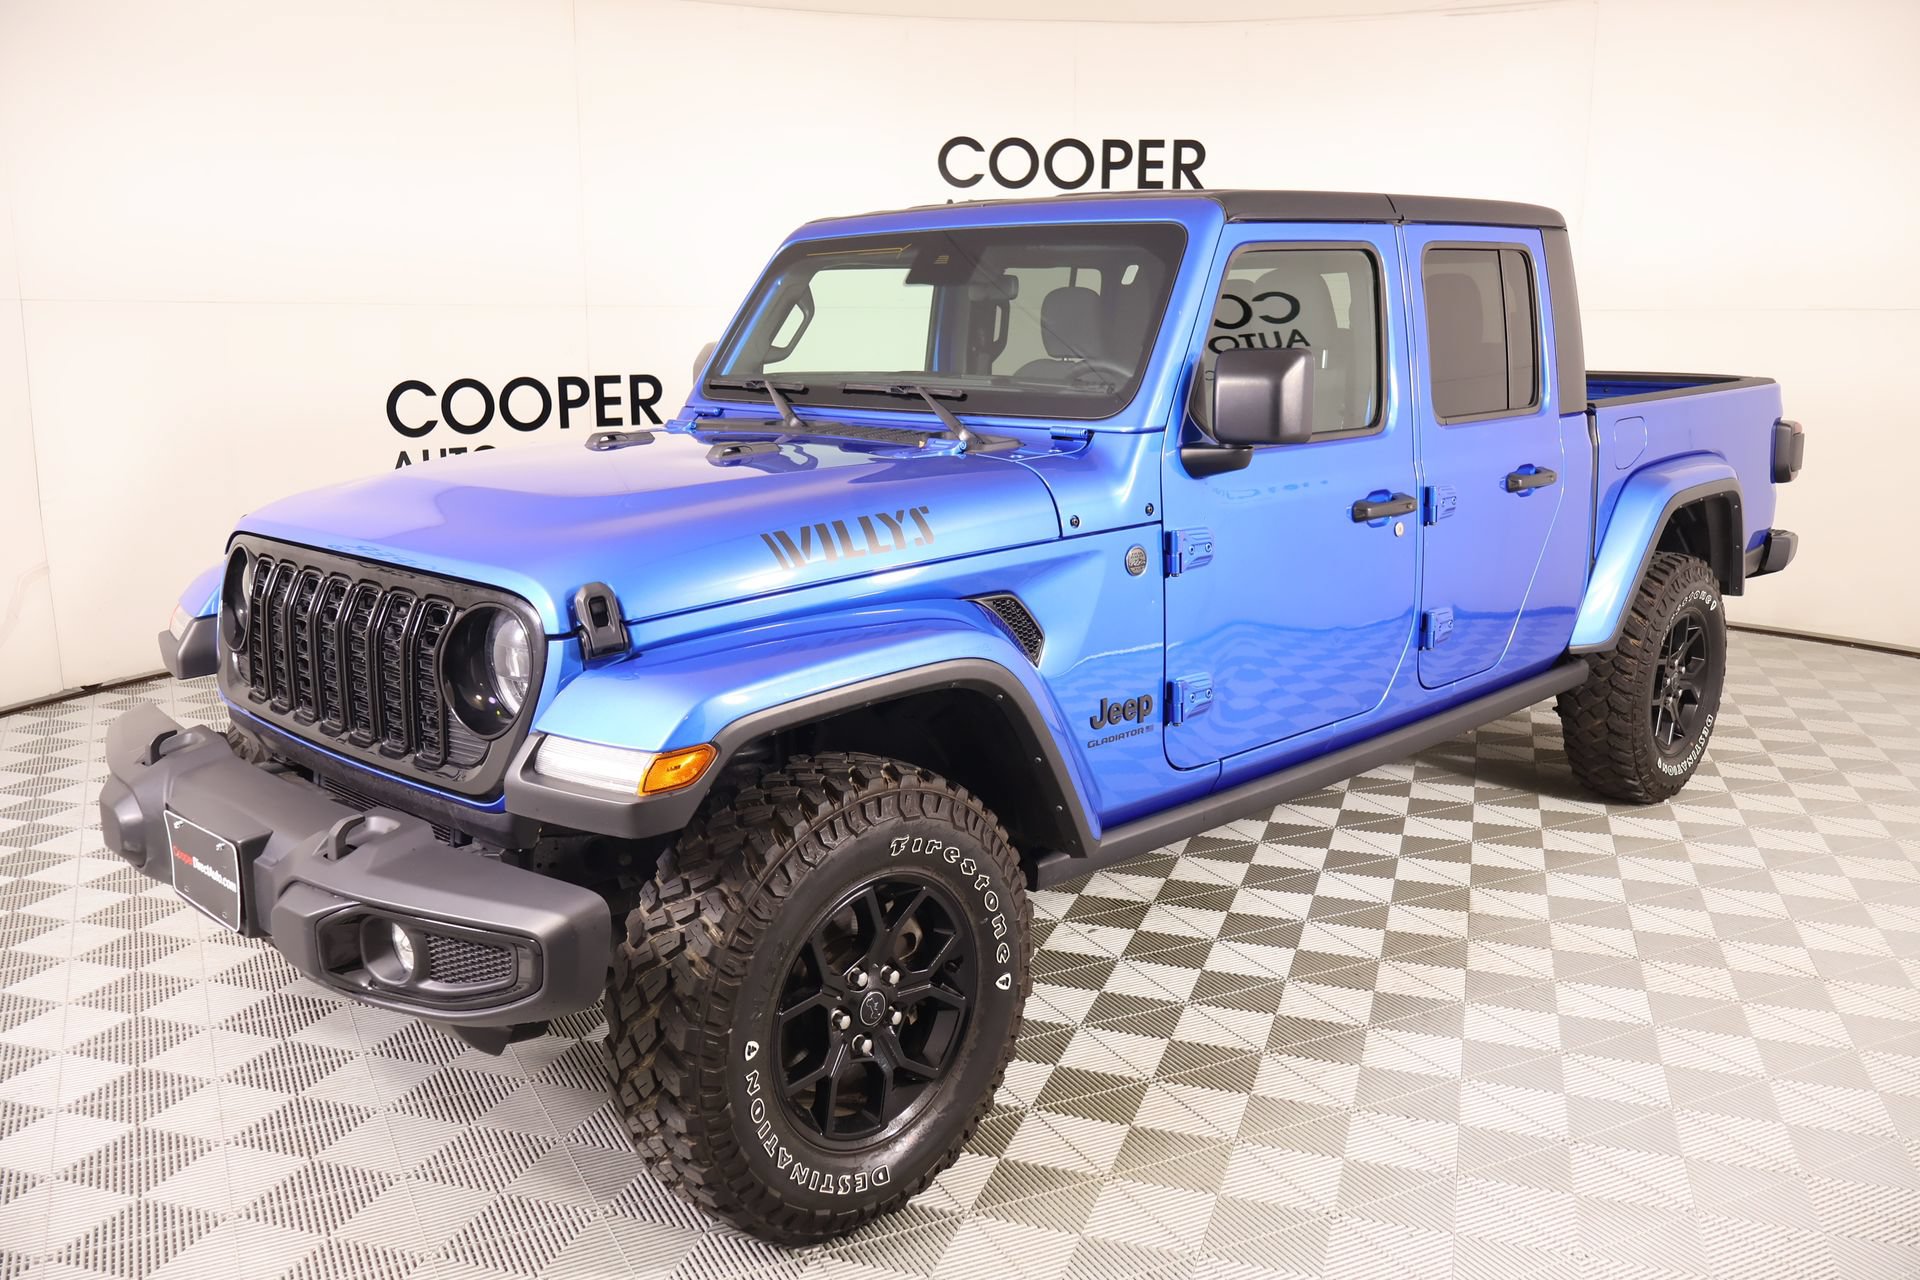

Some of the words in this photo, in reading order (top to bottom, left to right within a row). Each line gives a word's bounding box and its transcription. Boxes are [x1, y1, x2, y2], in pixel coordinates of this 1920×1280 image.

[938, 136, 1206, 190] COOPER
[386, 374, 663, 438] COOPER
[760, 506, 935, 570] WILLYS
[1087, 727, 1144, 748] GLADIATOR
[1089, 694, 1153, 730] Jeep
[1662, 714, 1714, 776] DESTINATION
[890, 834, 1010, 964] Firestone
[745, 1070, 890, 1195] DESTINATION
